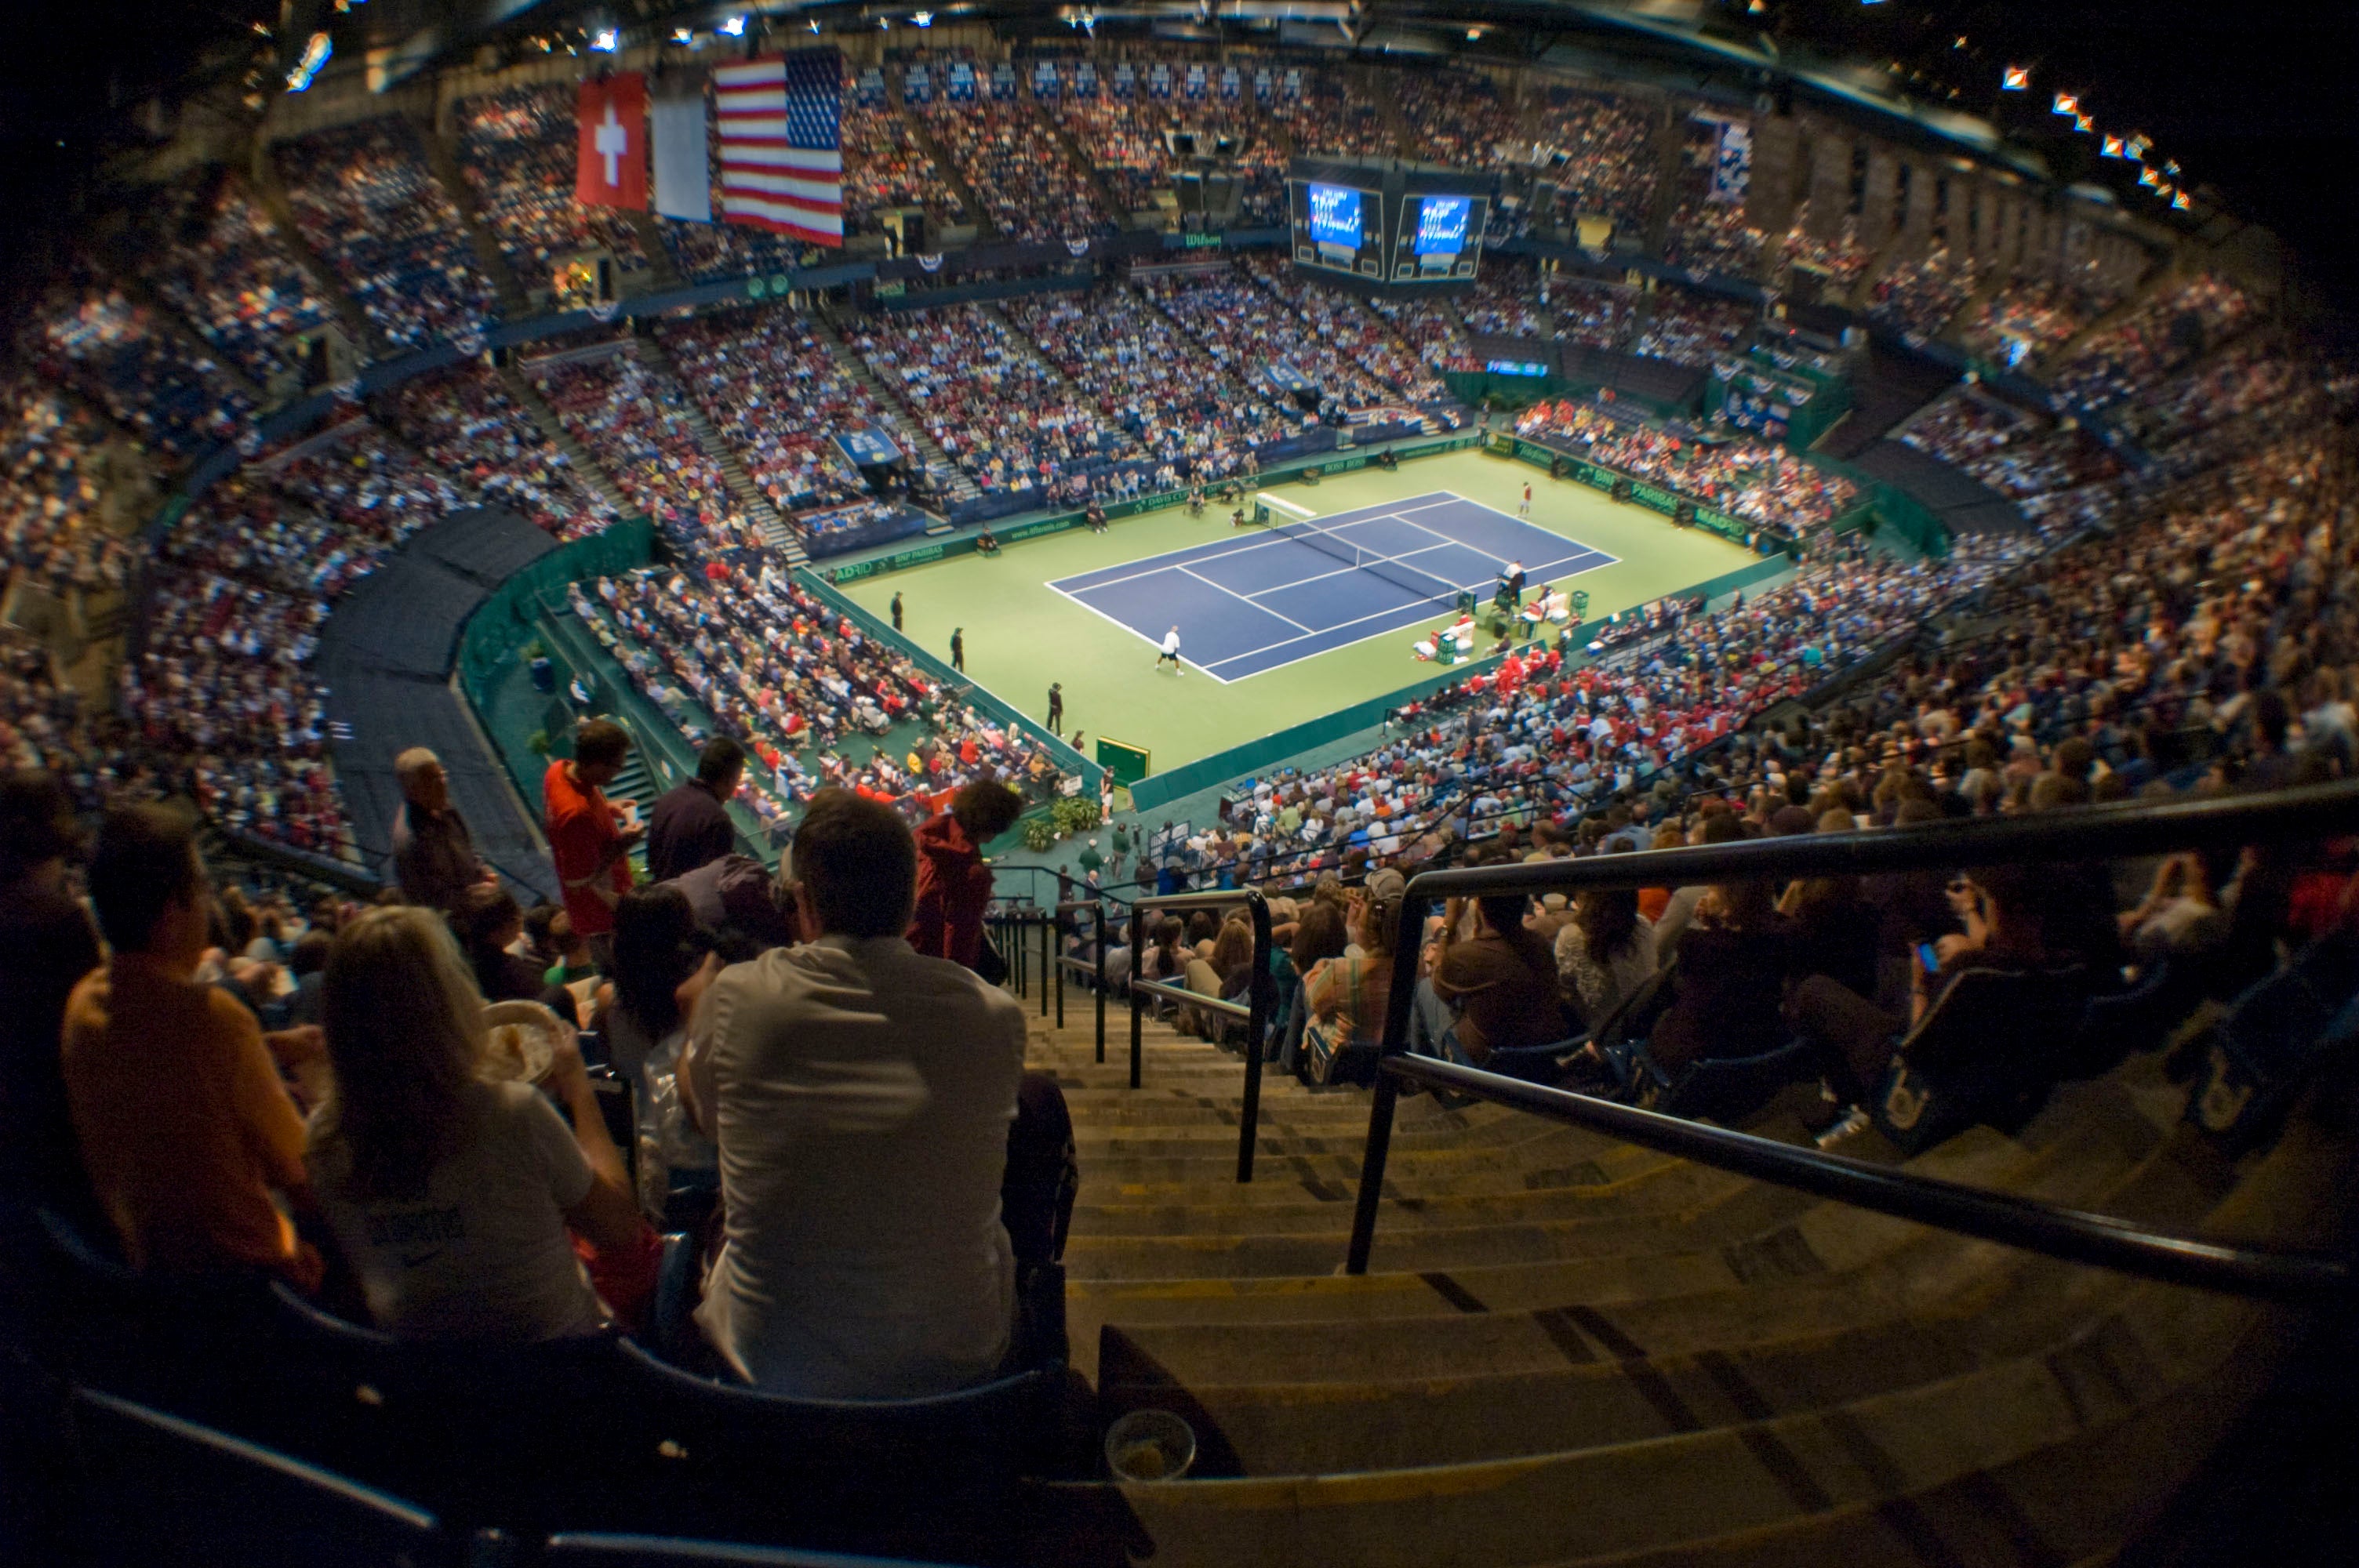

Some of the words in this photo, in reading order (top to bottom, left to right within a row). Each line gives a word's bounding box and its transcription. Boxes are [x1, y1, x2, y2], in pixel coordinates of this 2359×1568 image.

[1186, 233, 1221, 245] Wilson
[1148, 493, 1172, 506] DAVIS
[1696, 508, 1745, 536] MADRID
[895, 553, 911, 563] BNP
[912, 546, 943, 558] PARIBAS
